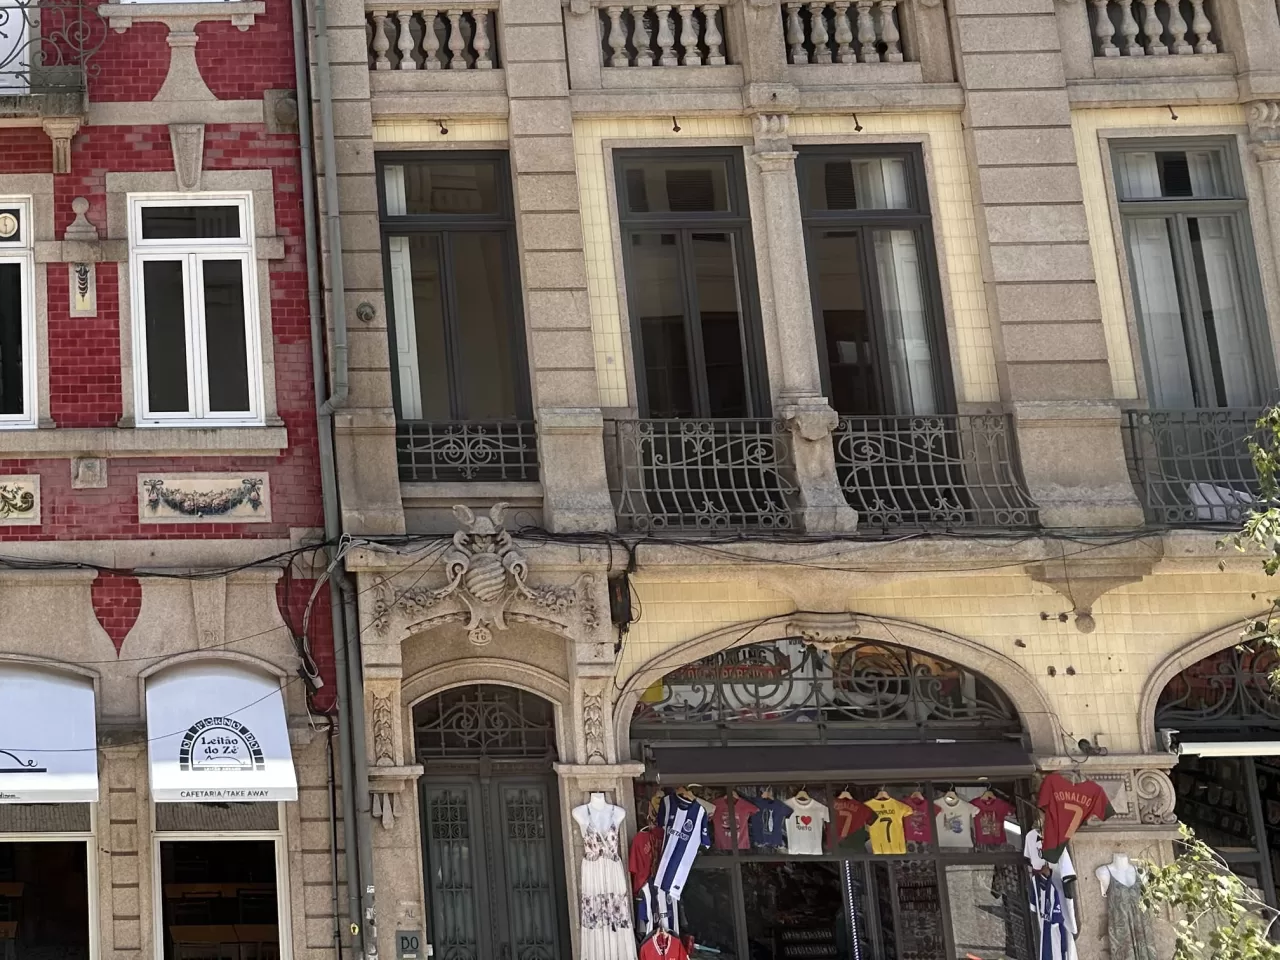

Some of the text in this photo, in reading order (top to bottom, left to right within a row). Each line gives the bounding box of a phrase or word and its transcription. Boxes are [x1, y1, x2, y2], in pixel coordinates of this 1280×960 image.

[474, 630, 487, 641] 76
[201, 736, 238, 745] Leitão
[204, 745, 238, 754] do Zé
[180, 790, 245, 798] CAFETARIA/TAKE
[1053, 791, 1093, 807] RONALDO
[838, 810, 853, 838] 7
[1064, 803, 1084, 839] 7
[880, 817, 892, 843] 7
[404, 910, 416, 919] AL
